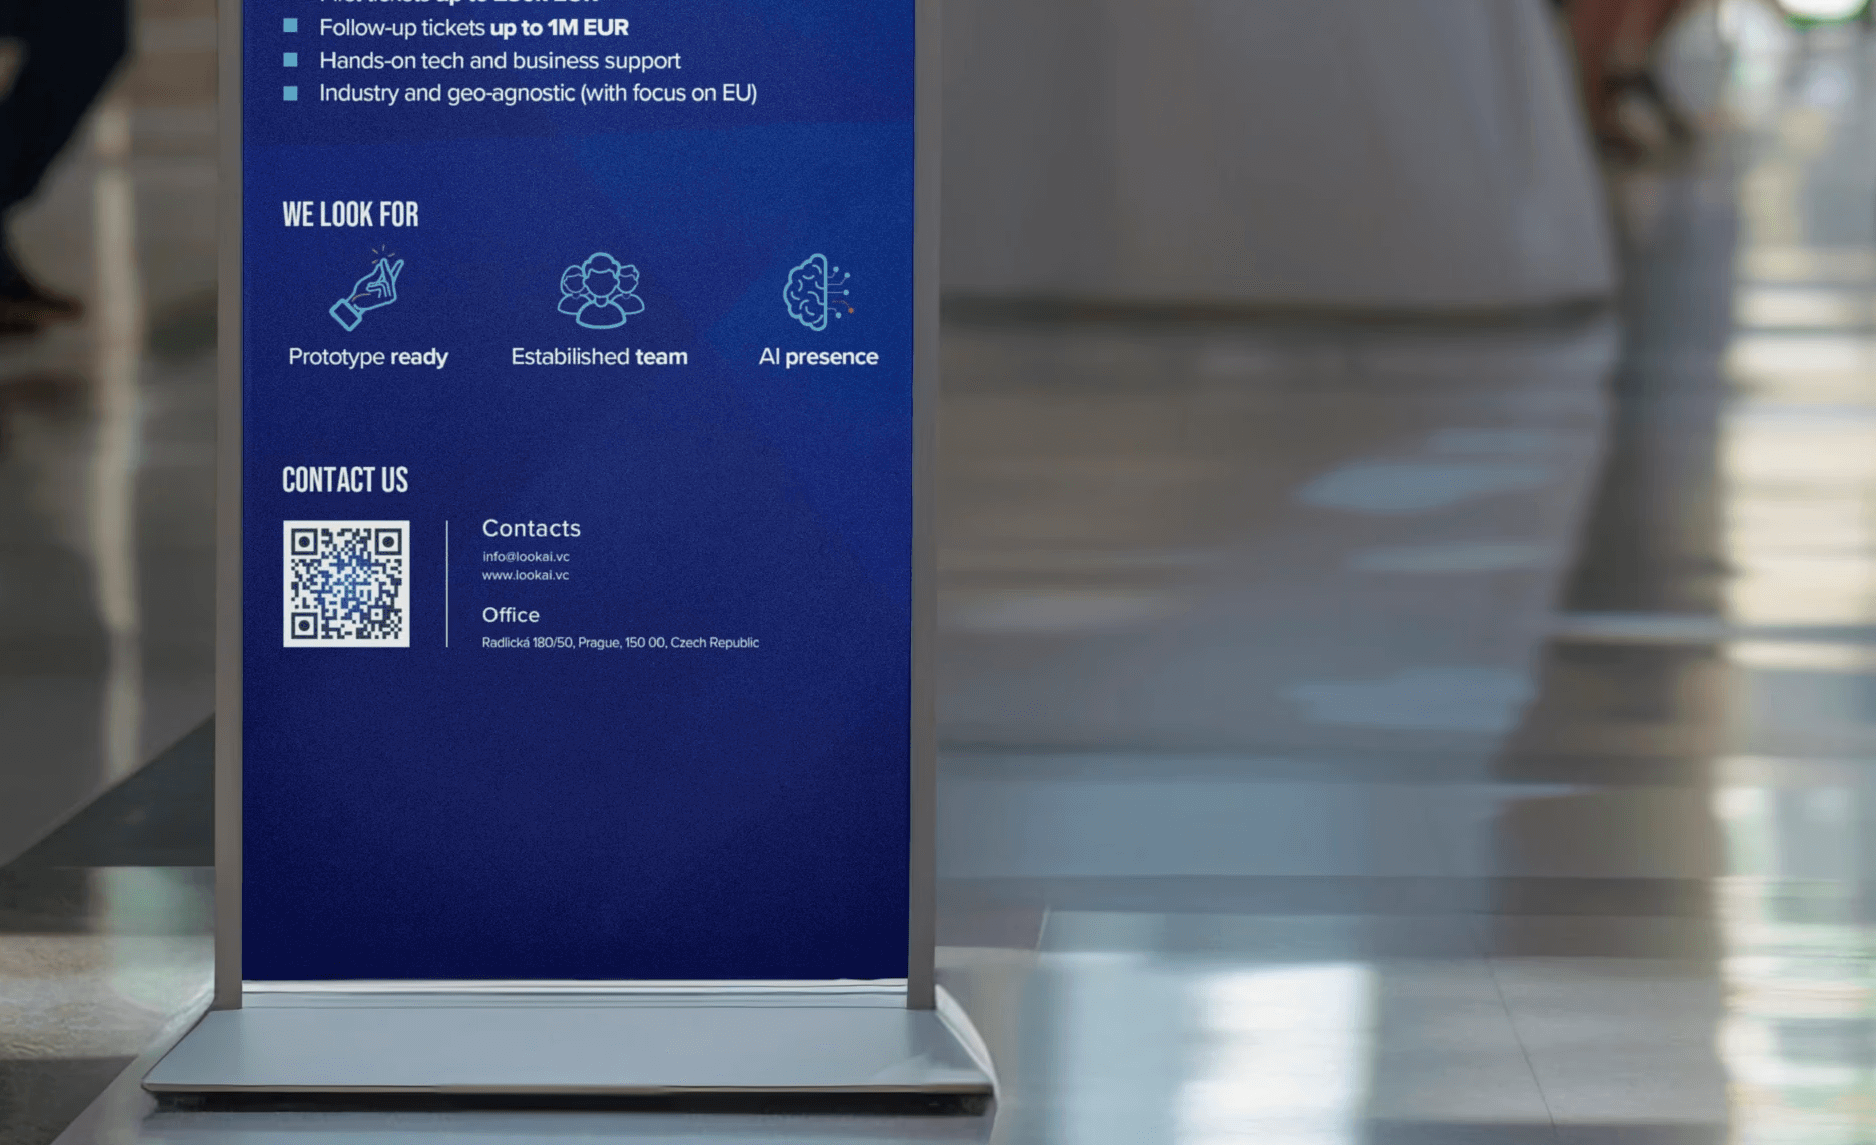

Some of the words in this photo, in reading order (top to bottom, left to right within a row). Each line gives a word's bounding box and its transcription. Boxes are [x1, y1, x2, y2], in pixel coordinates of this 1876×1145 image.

[320, 18, 417, 40] Follow-up
[421, 18, 486, 37] tickets
[490, 22, 518, 41] up
[520, 19, 544, 37] to
[547, 18, 579, 36] 1M
[583, 18, 629, 37] EUR
[320, 51, 416, 70] Hands-on
[420, 51, 464, 70] tech
[469, 51, 507, 70] and
[513, 51, 600, 70] business
[605, 52, 682, 74] support
[320, 83, 400, 107] Industry
[404, 83, 441, 102] and
[447, 83, 576, 107] geo-agnostic
[580, 83, 627, 106] (with
[632, 82, 687, 102] focus
[691, 87, 717, 102] on
[723, 83, 757, 106] EU)
[282, 200, 314, 227] WE
[320, 200, 373, 228] LOOK
[379, 200, 419, 227] FOR
[289, 347, 385, 370] Prototype
[390, 347, 449, 370] ready
[512, 347, 630, 366] Estabilished
[635, 348, 688, 366] team
[758, 347, 780, 365] AI
[785, 351, 879, 369] presence
[282, 466, 376, 493] CONTACT
[381, 465, 408, 493] US
[482, 518, 581, 537] Contacts
[482, 551, 570, 563] info@lookai.vc
[481, 569, 570, 581] www.lookai.vc
[482, 606, 540, 623] Office
[482, 636, 530, 648] Radlická
[532, 636, 576, 649] 180/50,
[578, 636, 623, 651] Prague,
[625, 636, 646, 648] 150
[648, 636, 668, 649] 00,
[670, 636, 707, 648] Czech
[709, 636, 760, 650] Republic
